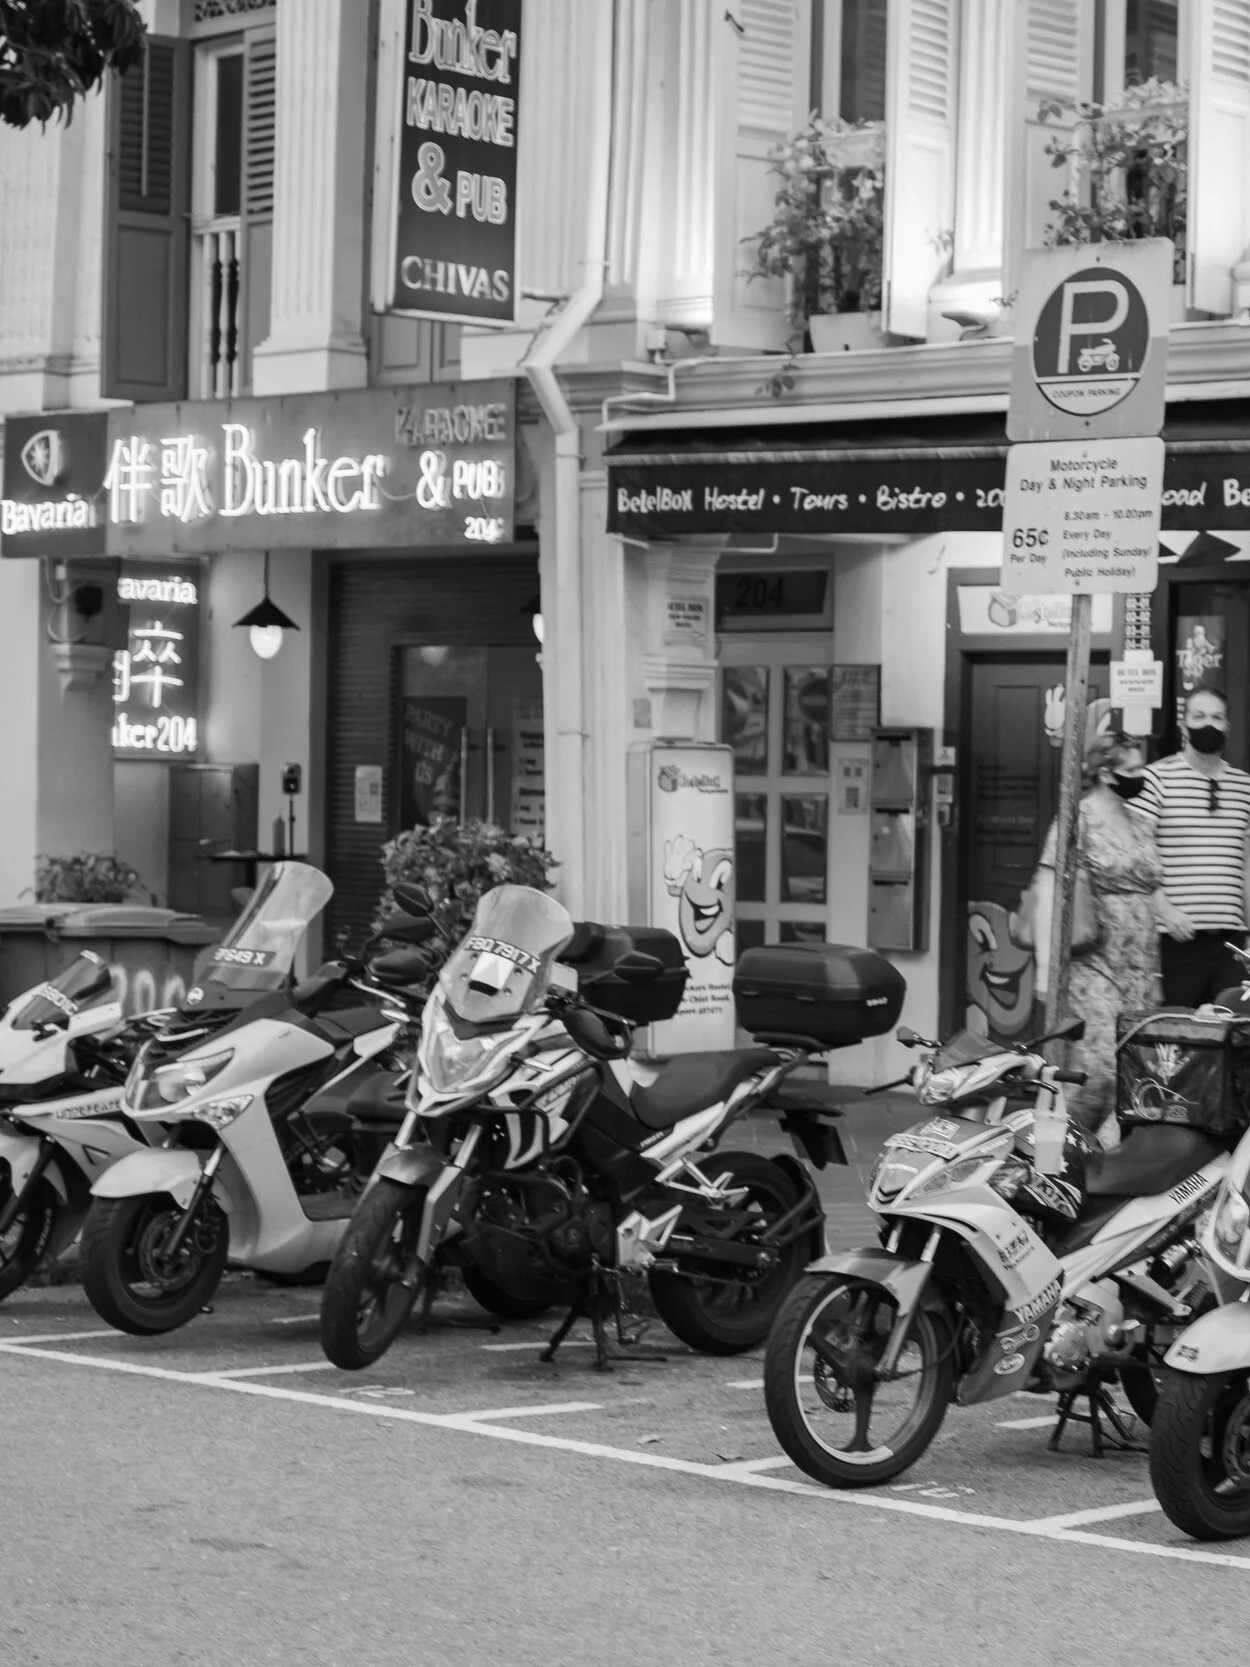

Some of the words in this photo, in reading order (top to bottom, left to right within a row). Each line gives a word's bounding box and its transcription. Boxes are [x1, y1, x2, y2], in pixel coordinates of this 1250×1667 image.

[406, 77, 514, 147] KARAOKE
[411, 141, 453, 215] &
[456, 171, 508, 224] PUB
[401, 255, 511, 302] CHIVAS
[1057, 279, 1130, 374] P
[1052, 388, 1085, 399] COUPON
[1087, 387, 1122, 397] PARKING
[219, 423, 387, 518] Bunker
[415, 450, 448, 510] &
[452, 458, 505, 500] PUB
[1050, 457, 1119, 473] Motorcycle
[704, 486, 766, 511] Hostel
[790, 486, 849, 510] Tours
[876, 485, 947, 510] Bistro
[1160, 480, 1207, 507] oad
[1020, 478, 1043, 495] Day
[1048, 478, 1057, 491] &
[1063, 477, 1096, 492] Night
[1101, 475, 1148, 489] Parking
[2, 493, 96, 536] Bavaria
[1063, 530, 1090, 541] Every
[1093, 529, 1112, 540] Day
[1010, 553, 1026, 564] Per
[1029, 553, 1047, 565] Day
[1064, 567, 1093, 577] Public
[117, 575, 199, 605] avaria
[735, 576, 785, 608] 204
[405, 702, 454, 736] PARTY
[405, 728, 444, 763] WITH
[1168, 1172, 1210, 1206] YAMAHA
